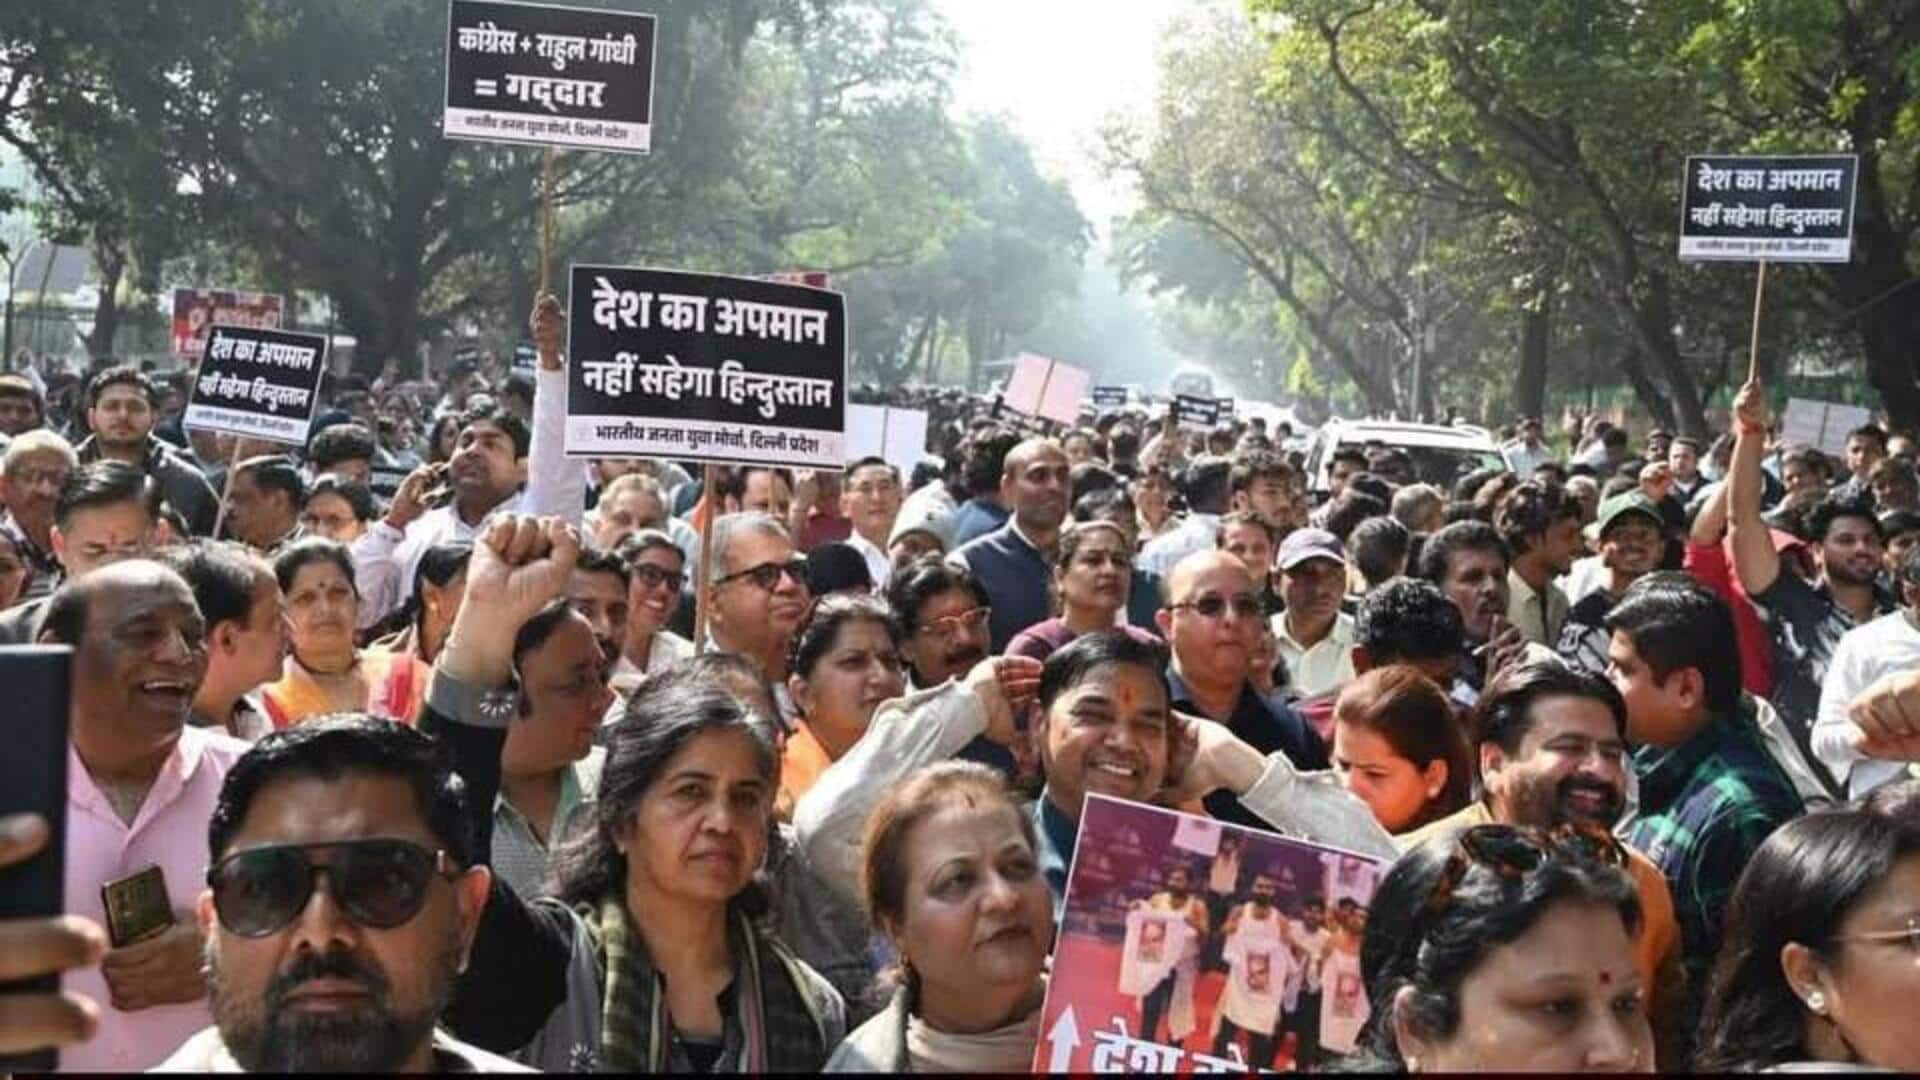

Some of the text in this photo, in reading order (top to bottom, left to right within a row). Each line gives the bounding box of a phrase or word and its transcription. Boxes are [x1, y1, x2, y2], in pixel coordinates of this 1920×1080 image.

[458, 22, 517, 54] कांग्रेस
[535, 32, 587, 71] राहुल
[589, 33, 637, 65] गांधी
[1697, 162, 1843, 192] देश का अपमान
[1691, 202, 1843, 235] नहीं सहेगा हिन्दुस्तान
[592, 276, 828, 345] देश का अपमान
[211, 330, 233, 360] देश
[234, 339, 256, 362] का
[256, 341, 316, 371] अपमान
[582, 351, 639, 397] नहीं
[639, 354, 714, 401] सहेगा
[719, 359, 834, 418] हिन्दुस्तान
[596, 421, 644, 441] भारतीय
[648, 426, 684, 443] जनता
[687, 428, 712, 450] युवा
[749, 430, 787, 450] दिल्ली
[789, 435, 819, 454] प्रदेश
